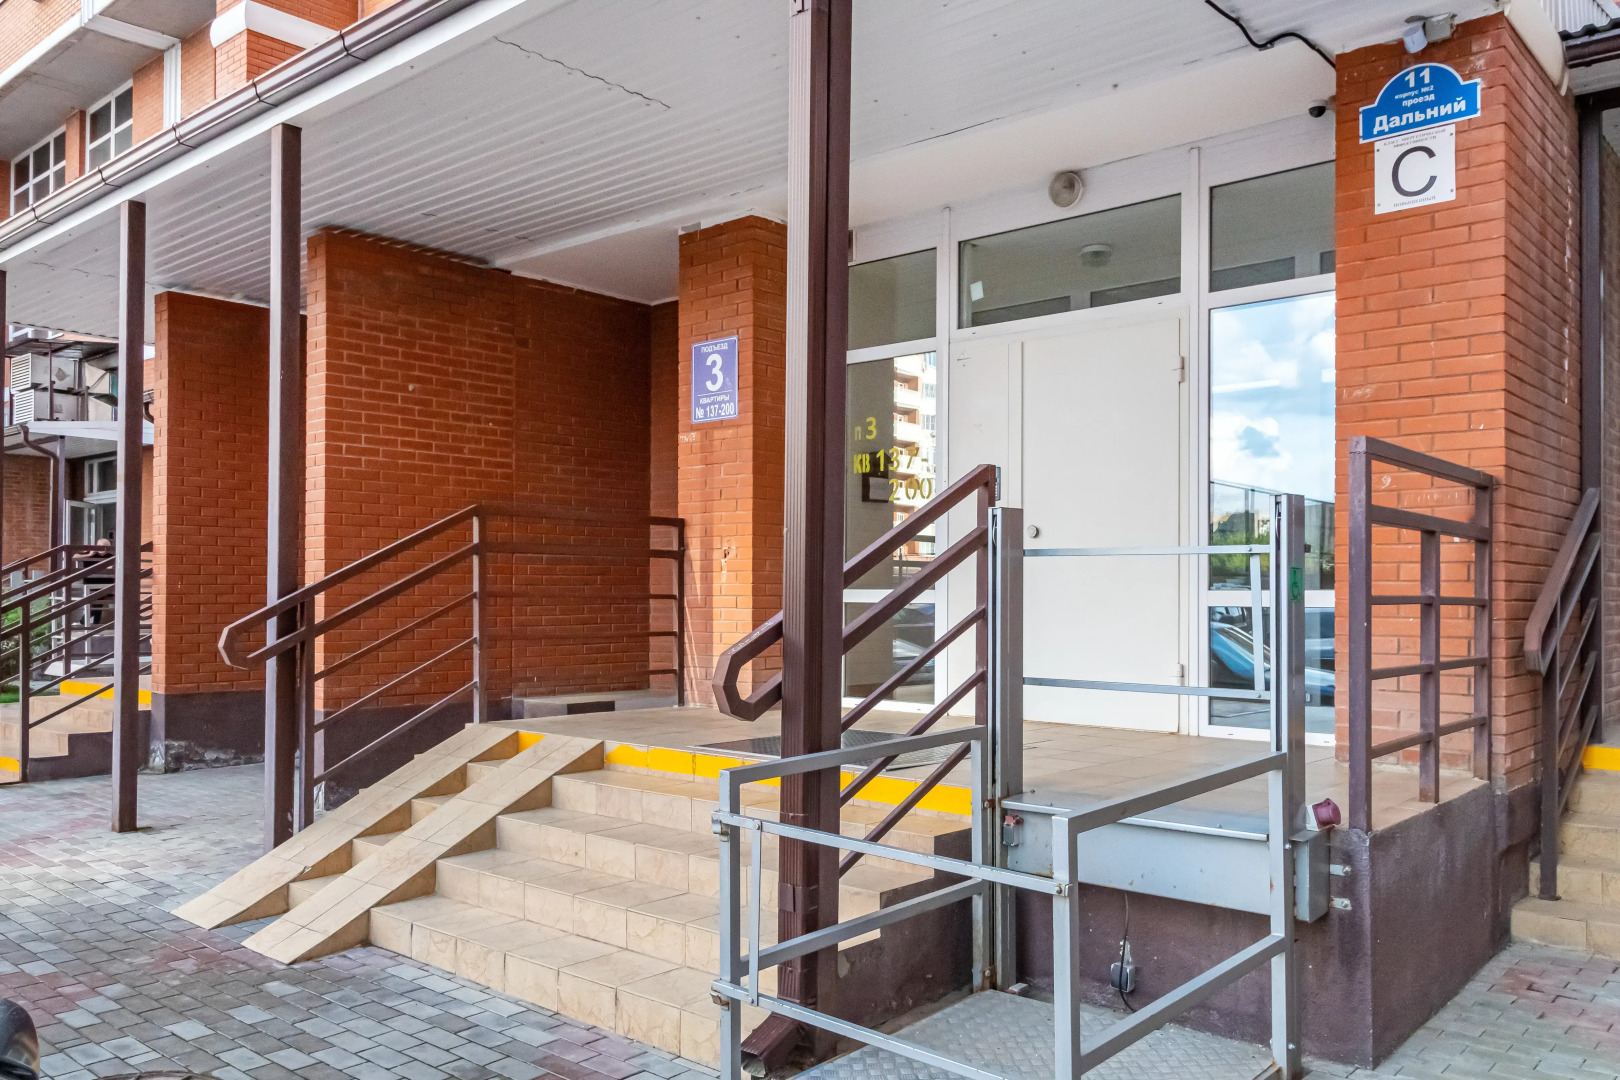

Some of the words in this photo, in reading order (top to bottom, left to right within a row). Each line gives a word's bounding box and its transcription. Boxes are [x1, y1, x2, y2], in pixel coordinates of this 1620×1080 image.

[1404, 67, 1431, 88] 11
[1395, 90, 1419, 99] корпус
[1402, 93, 1435, 106] проезд
[1373, 97, 1466, 134] Дальний
[701, 343, 728, 353] ПОДЪЕЗД
[705, 353, 724, 392] 3
[700, 394, 730, 404] КВАРТИРЫ
[695, 406, 704, 419] №
[705, 402, 735, 418] 137-200
[865, 416, 877, 440] 3
[888, 477, 932, 502] 200
